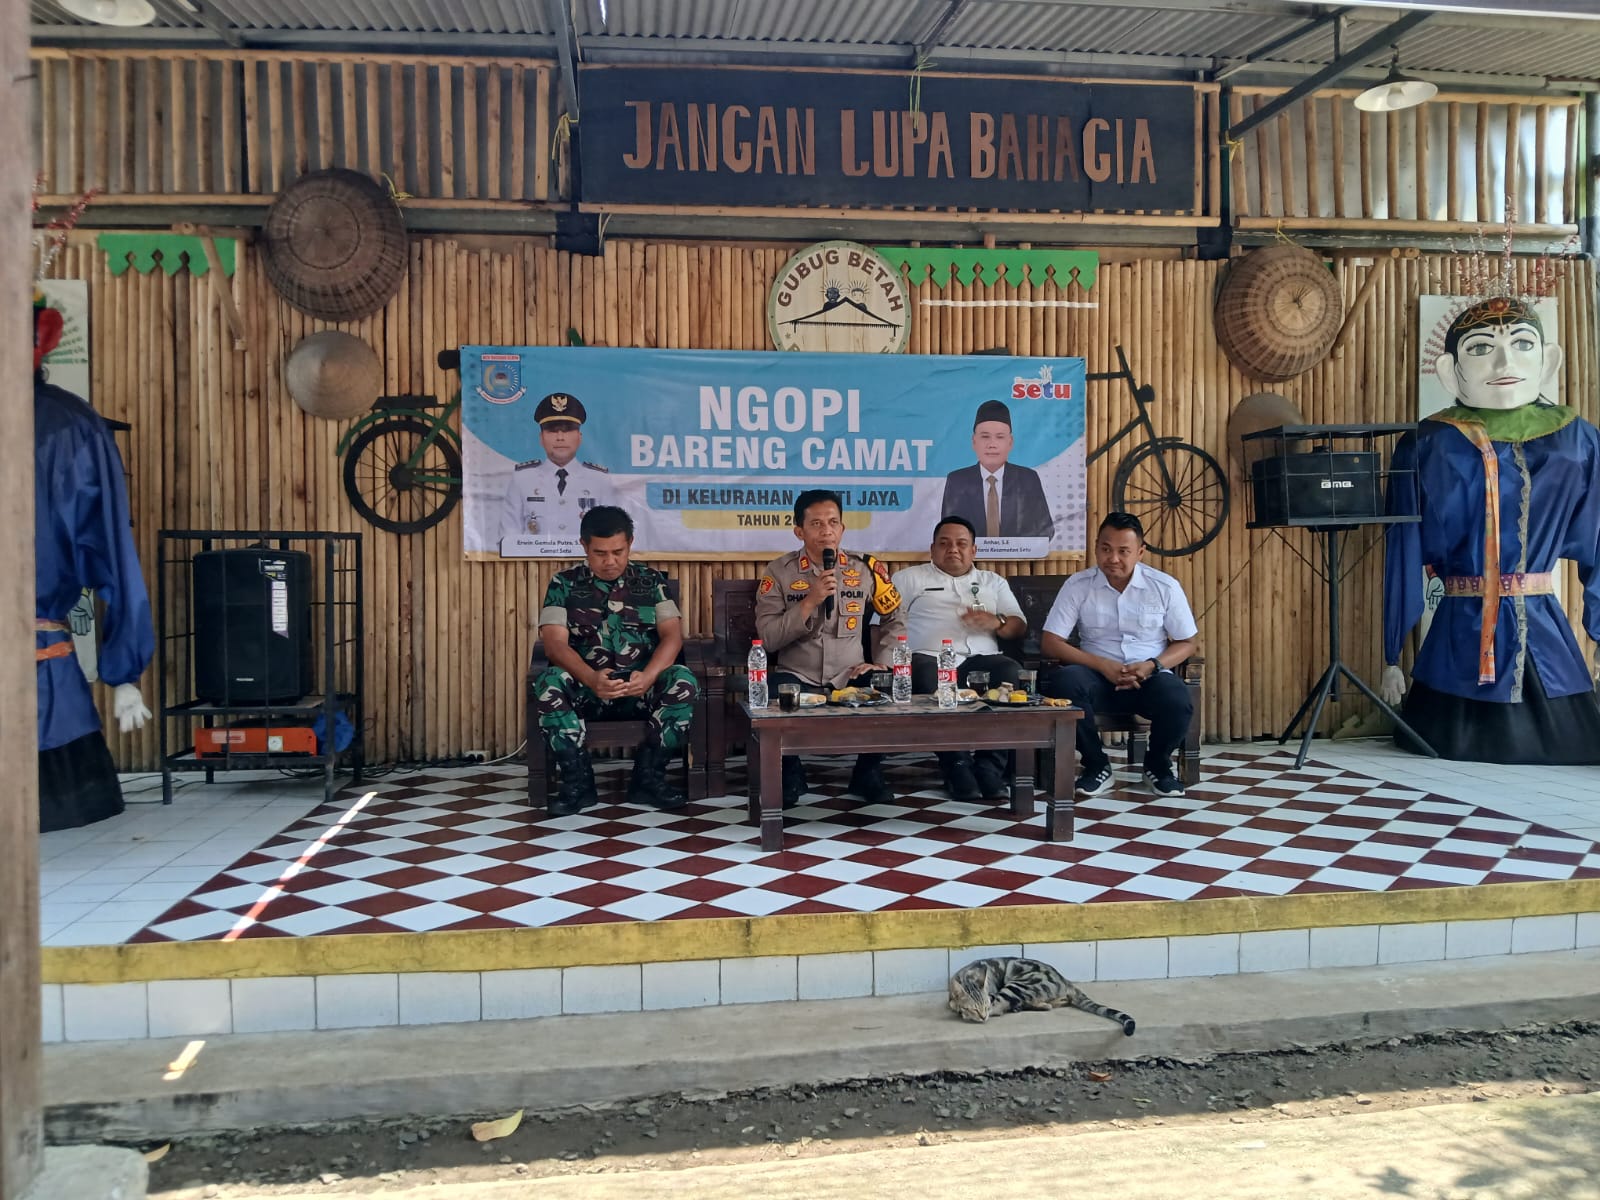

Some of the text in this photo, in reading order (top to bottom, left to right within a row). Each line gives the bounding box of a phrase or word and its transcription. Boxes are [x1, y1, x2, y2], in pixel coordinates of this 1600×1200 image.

[622, 100, 1157, 184] JANGAN LUPA BAHAGIA
[777, 249, 904, 312] GUBUG BETAH
[1012, 382, 1071, 399] setu
[700, 386, 861, 433] NGOPI
[631, 434, 933, 472] BARENG CAMAT
[662, 488, 681, 505] DI
[687, 488, 794, 506] KELURAHAN
[857, 490, 900, 506] JAYA
[736, 514, 780, 527] TAHUN
[840, 591, 864, 599] POLRI
